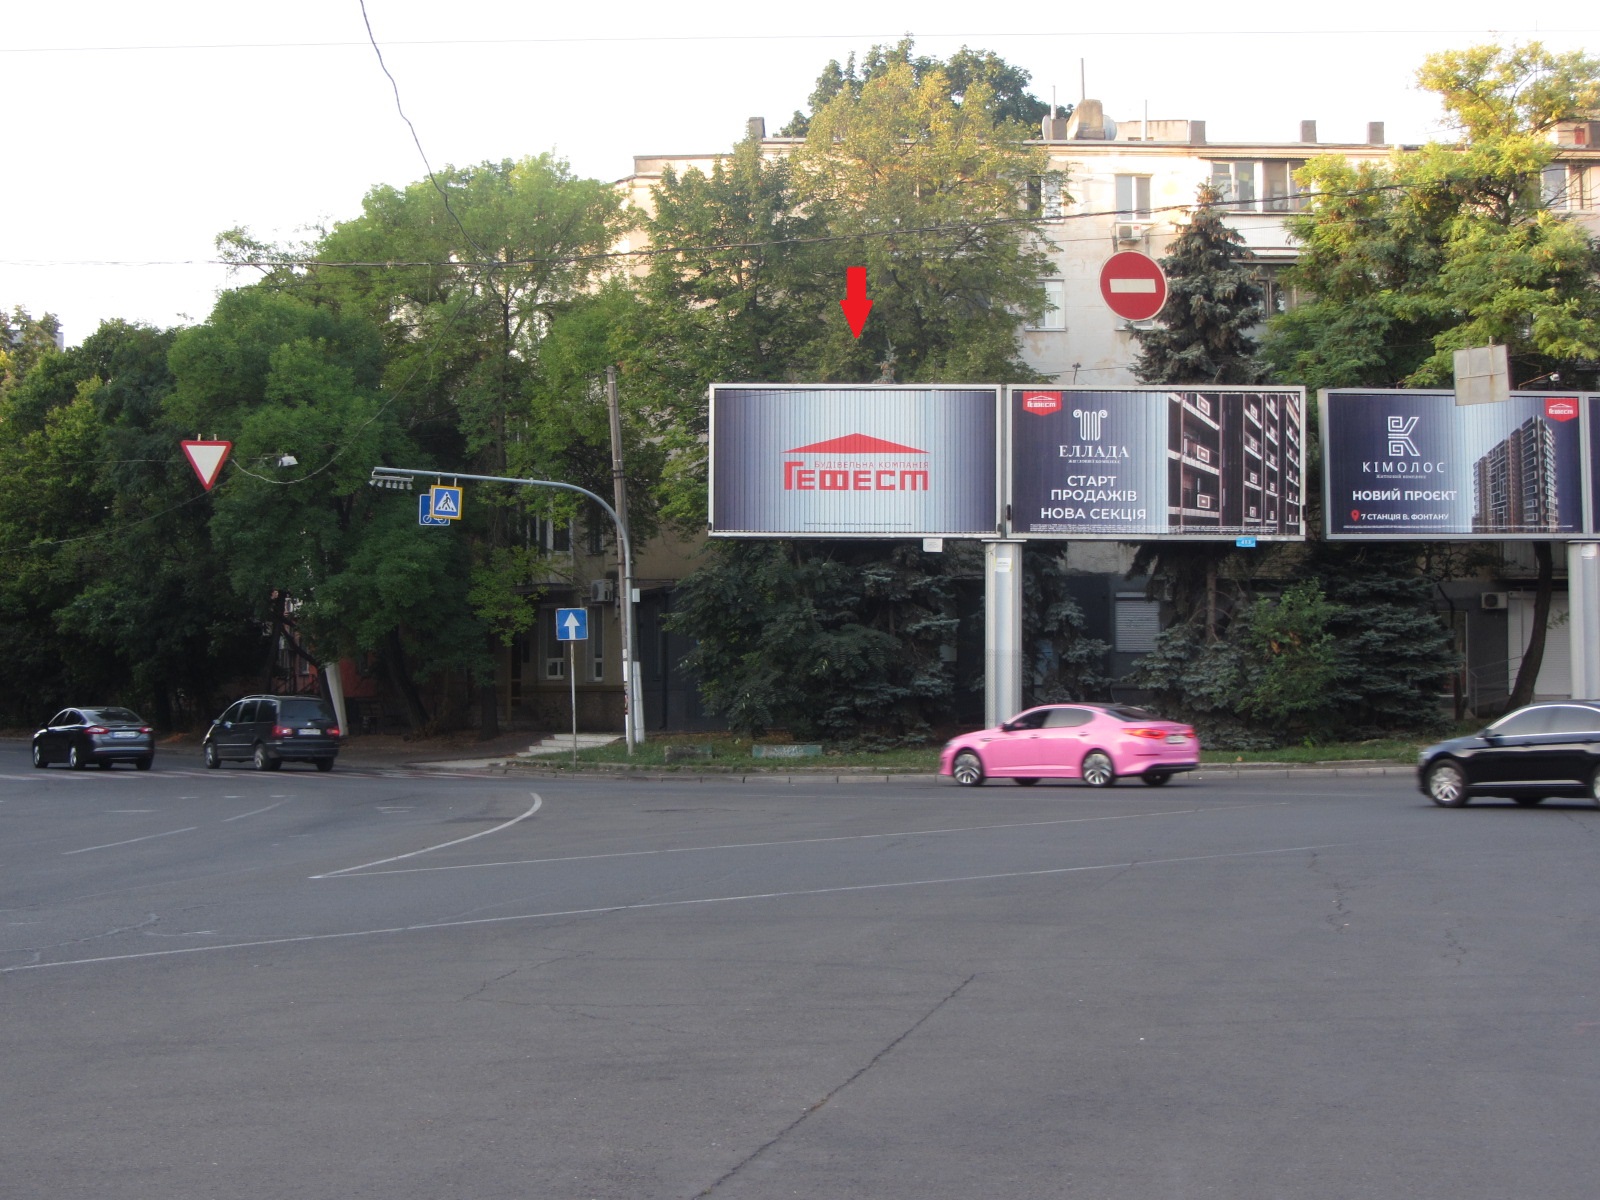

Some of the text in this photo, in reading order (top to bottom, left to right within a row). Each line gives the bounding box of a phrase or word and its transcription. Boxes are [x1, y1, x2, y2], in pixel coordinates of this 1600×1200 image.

[1059, 445, 1130, 459] ЕЛЛАДА
[814, 461, 929, 469] БУДІВЕЛЬНА КОМПАНІЯ
[1362, 462, 1445, 473] КІМОЛОС
[1067, 475, 1117, 487] СТАРТ
[1051, 489, 1137, 503] ПРОДАЖІВ
[1352, 488, 1457, 501] НОВИЙ ПРОЄКТ
[1041, 507, 1146, 521] НОВА СЕКЦІЯ
[1367, 513, 1401, 521] СТАНЦІЯ
